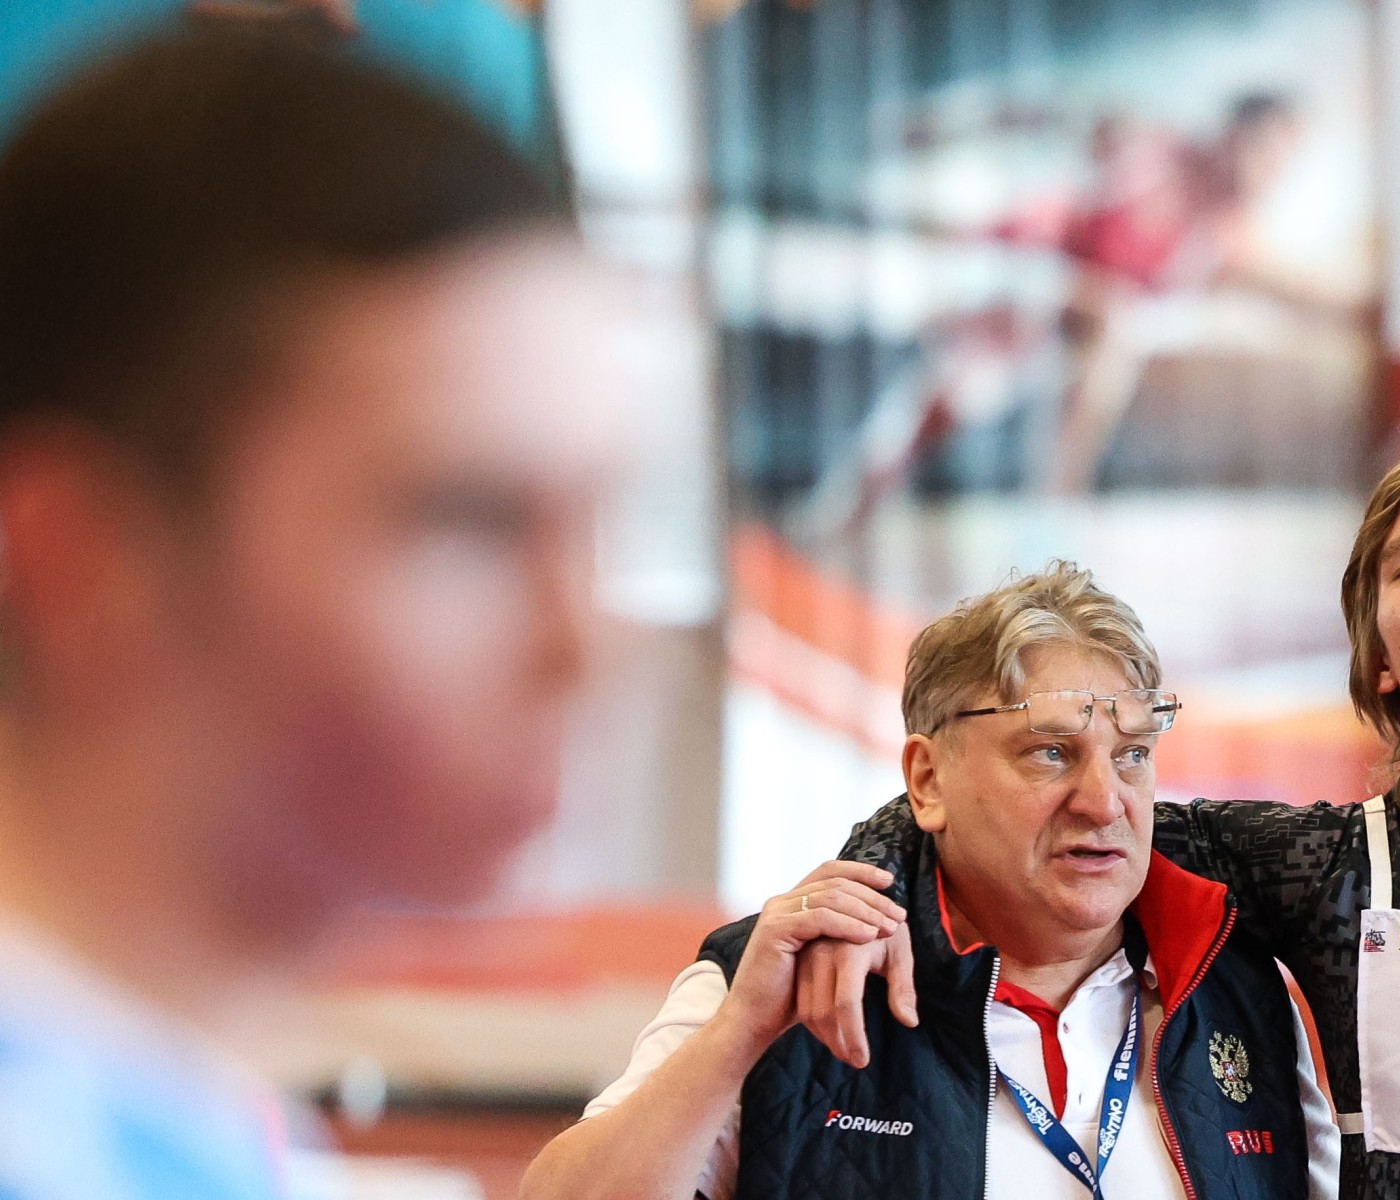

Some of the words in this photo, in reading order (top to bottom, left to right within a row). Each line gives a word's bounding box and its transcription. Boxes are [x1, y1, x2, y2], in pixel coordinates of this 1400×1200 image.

[825, 1110, 914, 1136] FORWARD
[1098, 1098, 1123, 1158] TRENTINO
[1225, 1129, 1274, 1155] RUS
